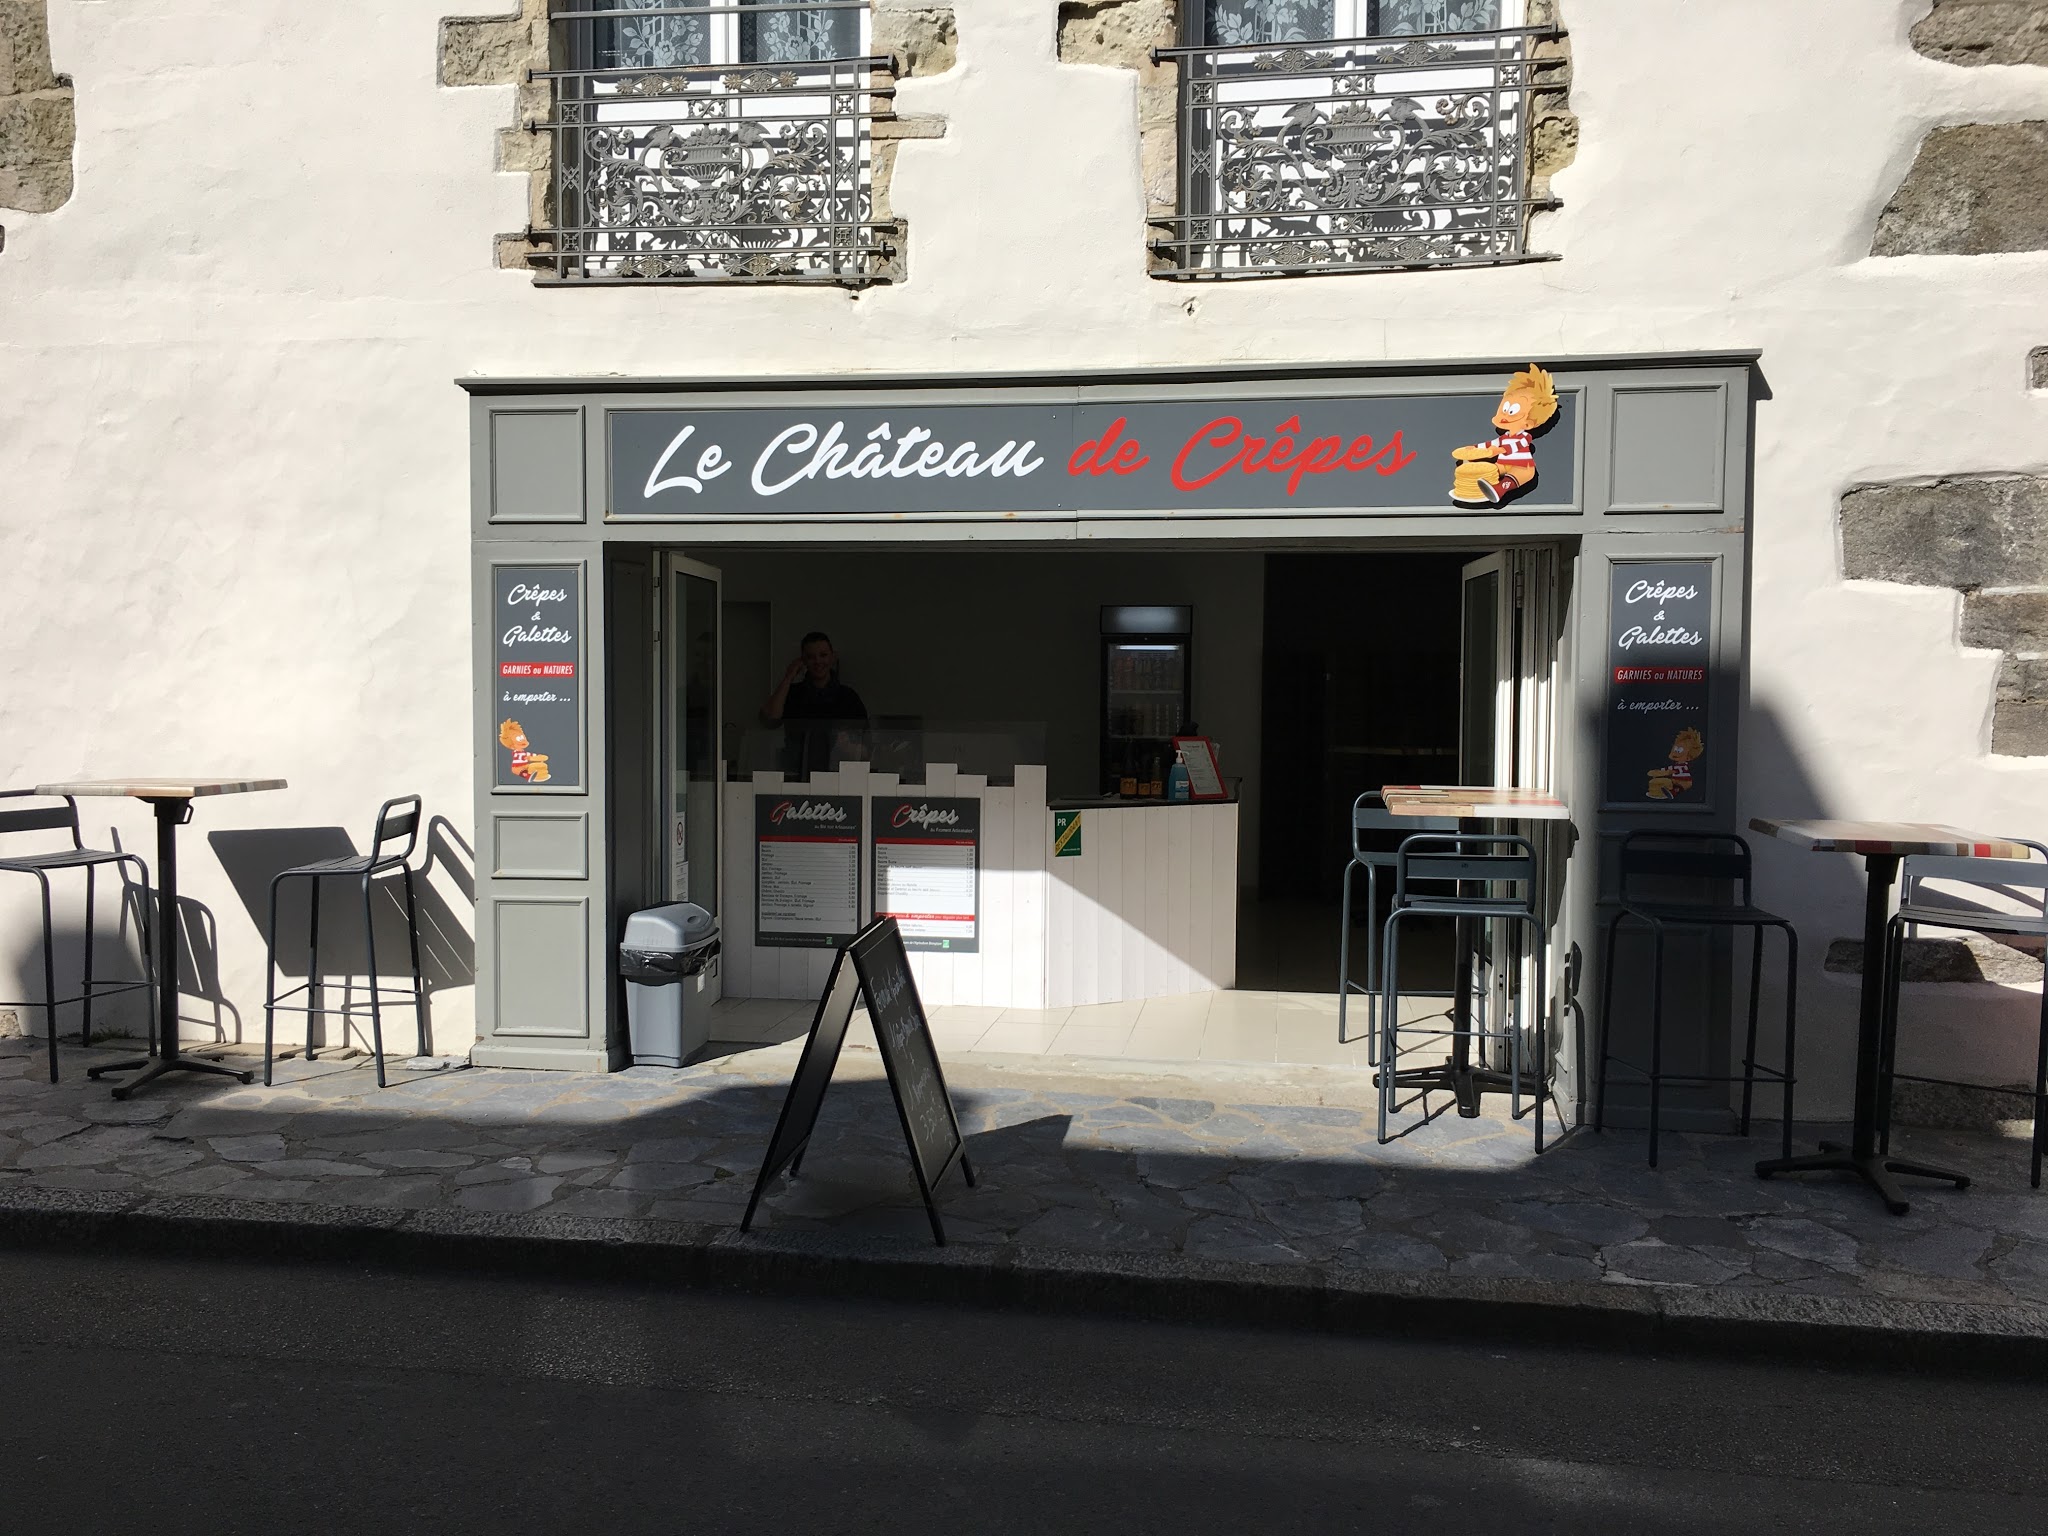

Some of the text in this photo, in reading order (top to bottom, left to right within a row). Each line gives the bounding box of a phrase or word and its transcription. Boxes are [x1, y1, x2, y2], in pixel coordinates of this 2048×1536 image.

[644, 414, 1418, 499] Le Château de Crêpes
[508, 584, 567, 606] Crêpes
[1625, 579, 1698, 605] Crêpes
[531, 611, 541, 621] &
[1653, 610, 1665, 621] &
[503, 625, 572, 647] Galettes
[1618, 625, 1702, 650] Galettes
[503, 665, 573, 675] GARNIES ou NATURES
[1617, 670, 1703, 680] GARNIES ou NATURES
[503, 691, 511, 702] à
[513, 691, 557, 705] emporter
[1617, 699, 1626, 710] à
[1629, 699, 1682, 714] emporter
[770, 800, 847, 825] Galettes
[891, 803, 959, 830] Crêpes
[1057, 818, 1066, 826] PR
